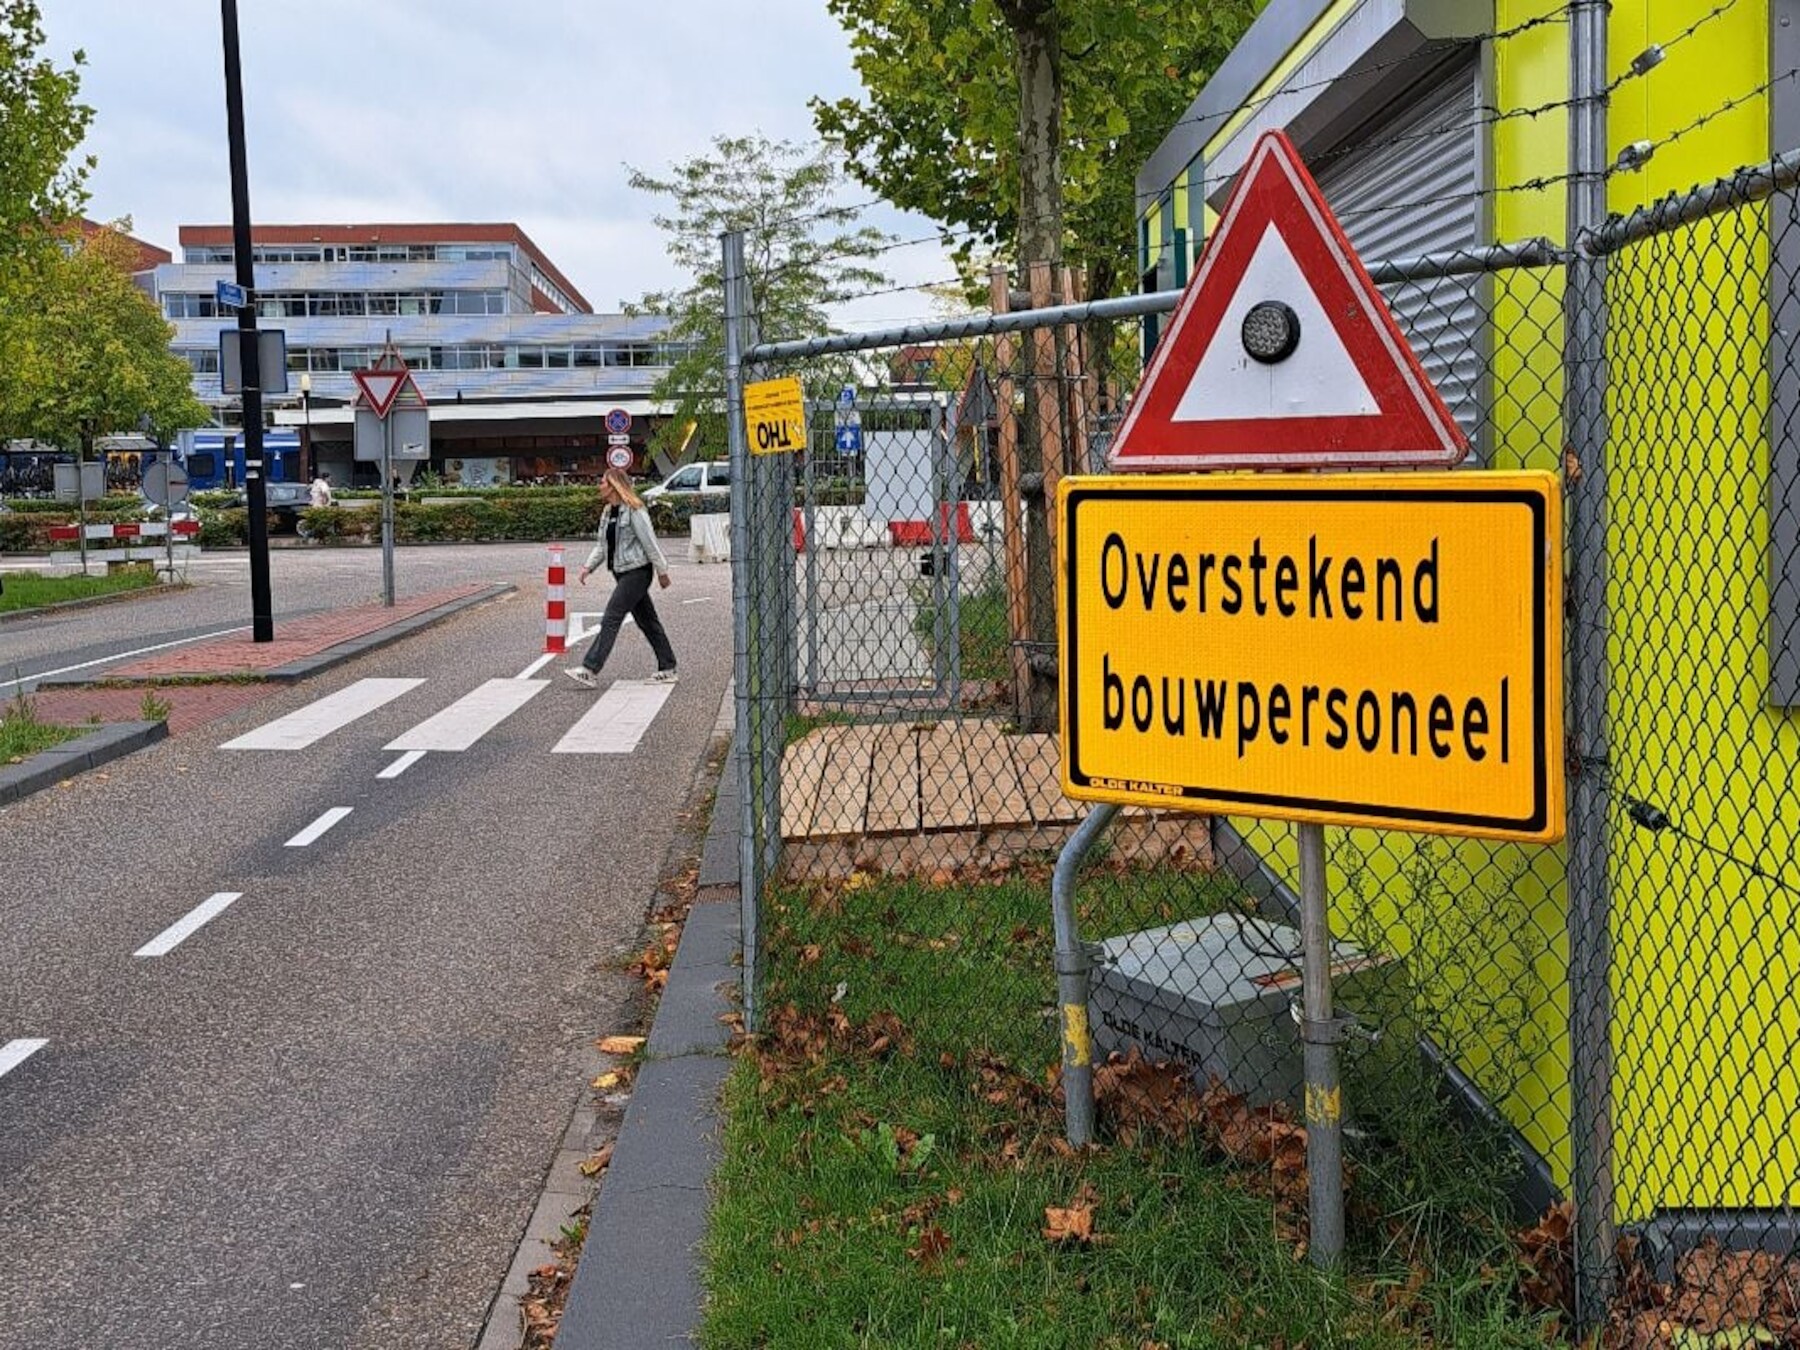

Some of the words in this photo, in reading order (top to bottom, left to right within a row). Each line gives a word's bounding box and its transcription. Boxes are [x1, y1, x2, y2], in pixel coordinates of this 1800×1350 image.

[1101, 532, 1439, 623] Overstekend
[1103, 653, 1509, 763] bouwpersoneel
[1089, 777, 1127, 790] OLDE
[1129, 780, 1184, 796] KALTER
[1102, 1011, 1140, 1040] OLDE
[1143, 1028, 1201, 1066] KALTER
